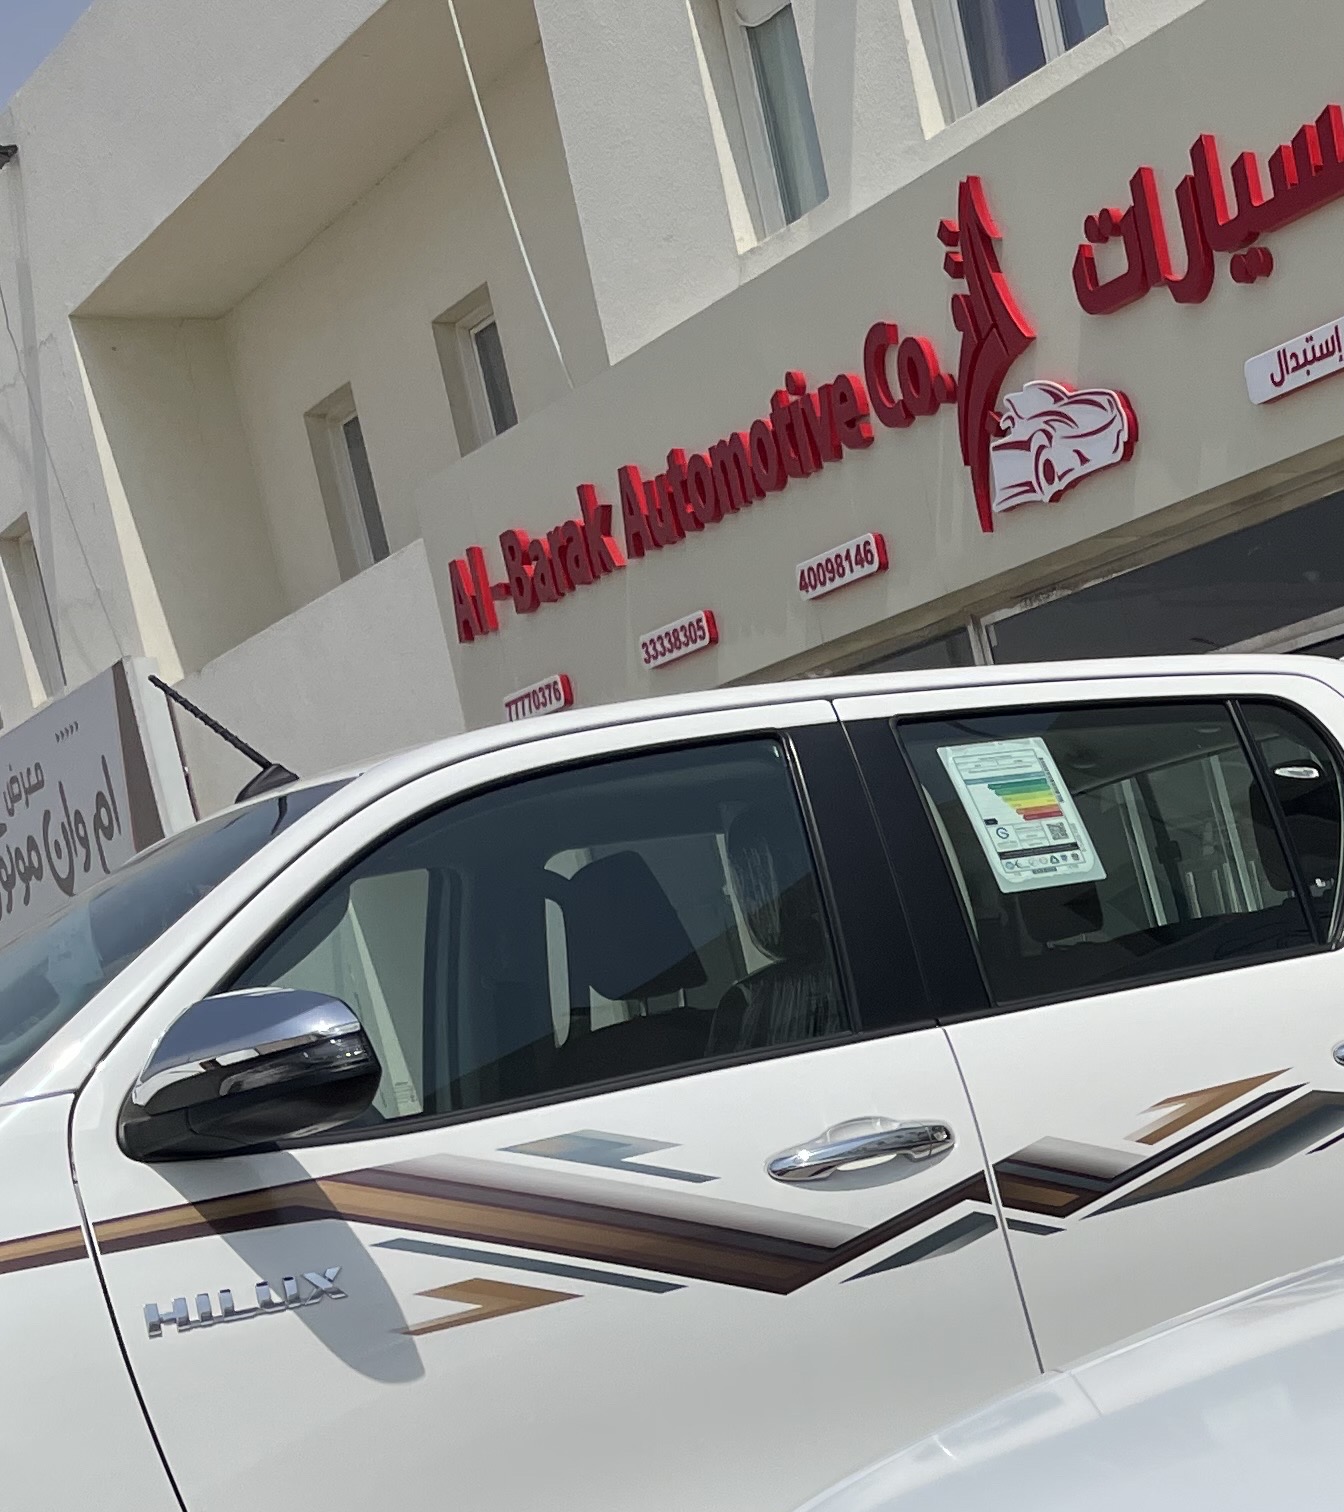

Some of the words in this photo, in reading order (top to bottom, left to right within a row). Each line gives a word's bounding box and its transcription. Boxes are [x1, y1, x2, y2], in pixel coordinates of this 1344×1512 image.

[1269, 324, 1344, 388] إستبدال
[448, 483, 627, 644] Al-Barak
[617, 370, 875, 560] Automotive
[863, 321, 959, 429] Co.
[799, 540, 875, 594] 40098146
[642, 617, 706, 665] 33338305
[505, 680, 561, 722] 77770376
[3, 761, 45, 818] معرض
[144, 1265, 348, 1338] HILUX
